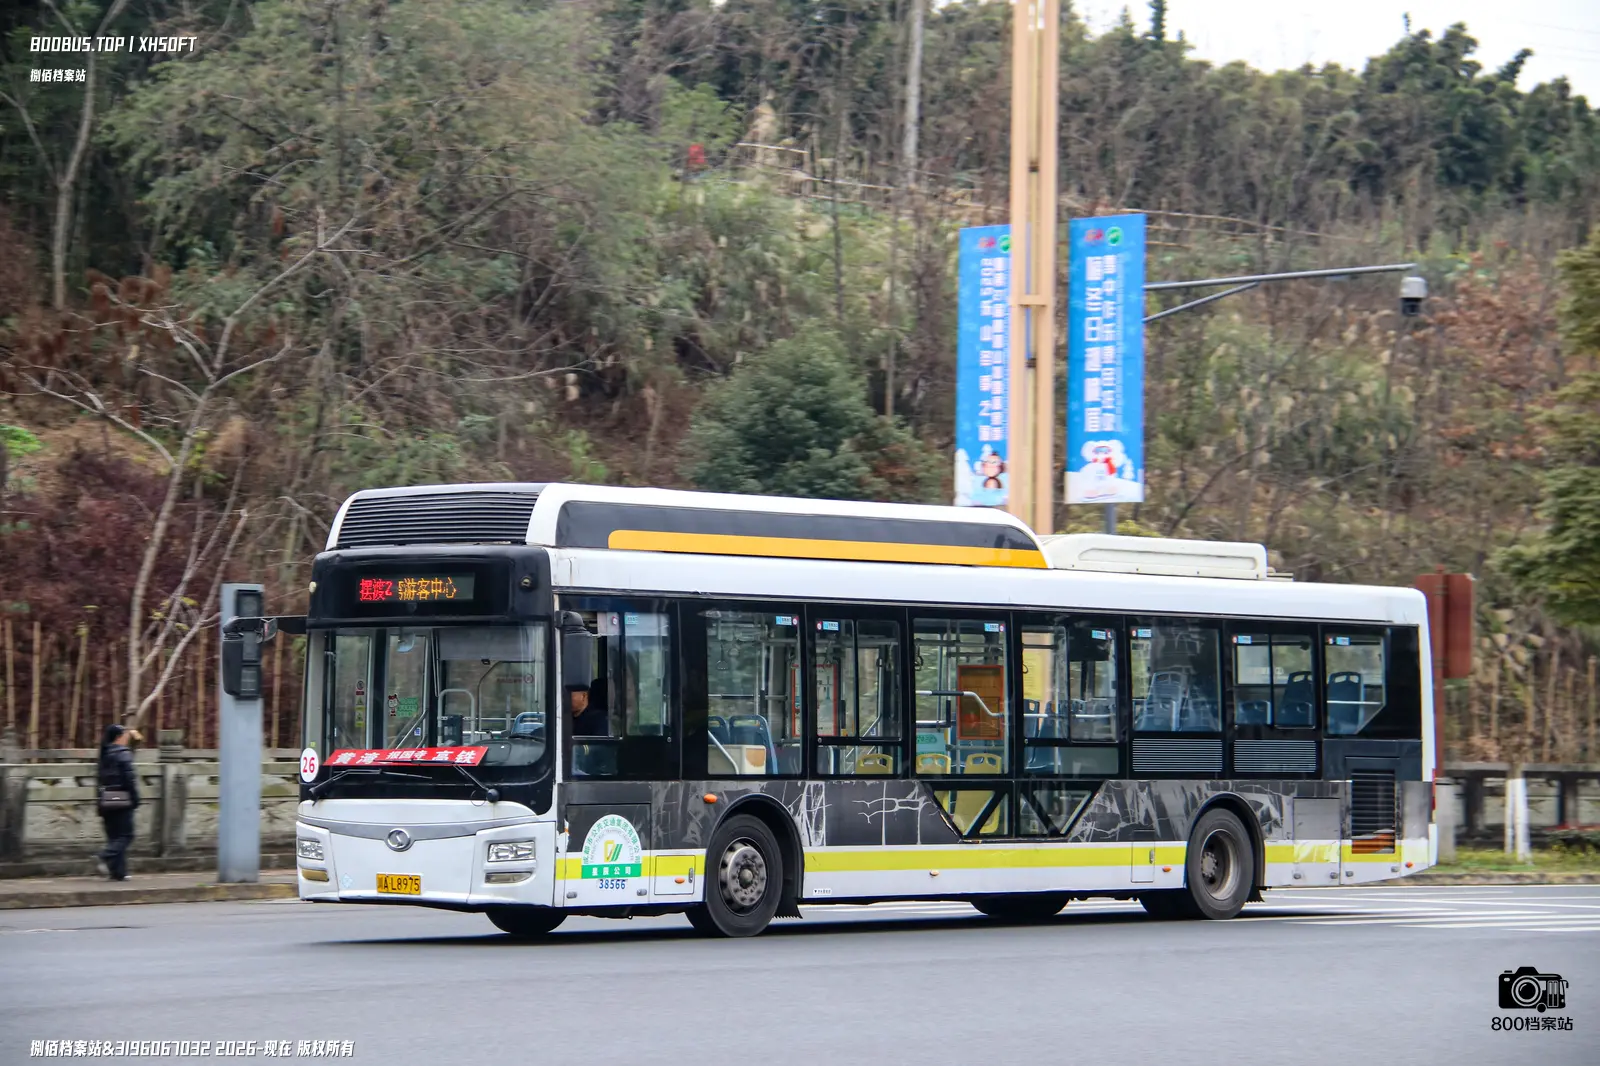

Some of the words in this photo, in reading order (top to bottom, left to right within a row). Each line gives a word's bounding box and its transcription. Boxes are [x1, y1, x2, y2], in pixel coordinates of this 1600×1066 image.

[302, 756, 315, 773] 26
[333, 752, 379, 765] 黄湾
[386, 751, 427, 761] 报国寺
[432, 750, 477, 764] 高铁
[599, 878, 626, 890] 38566
